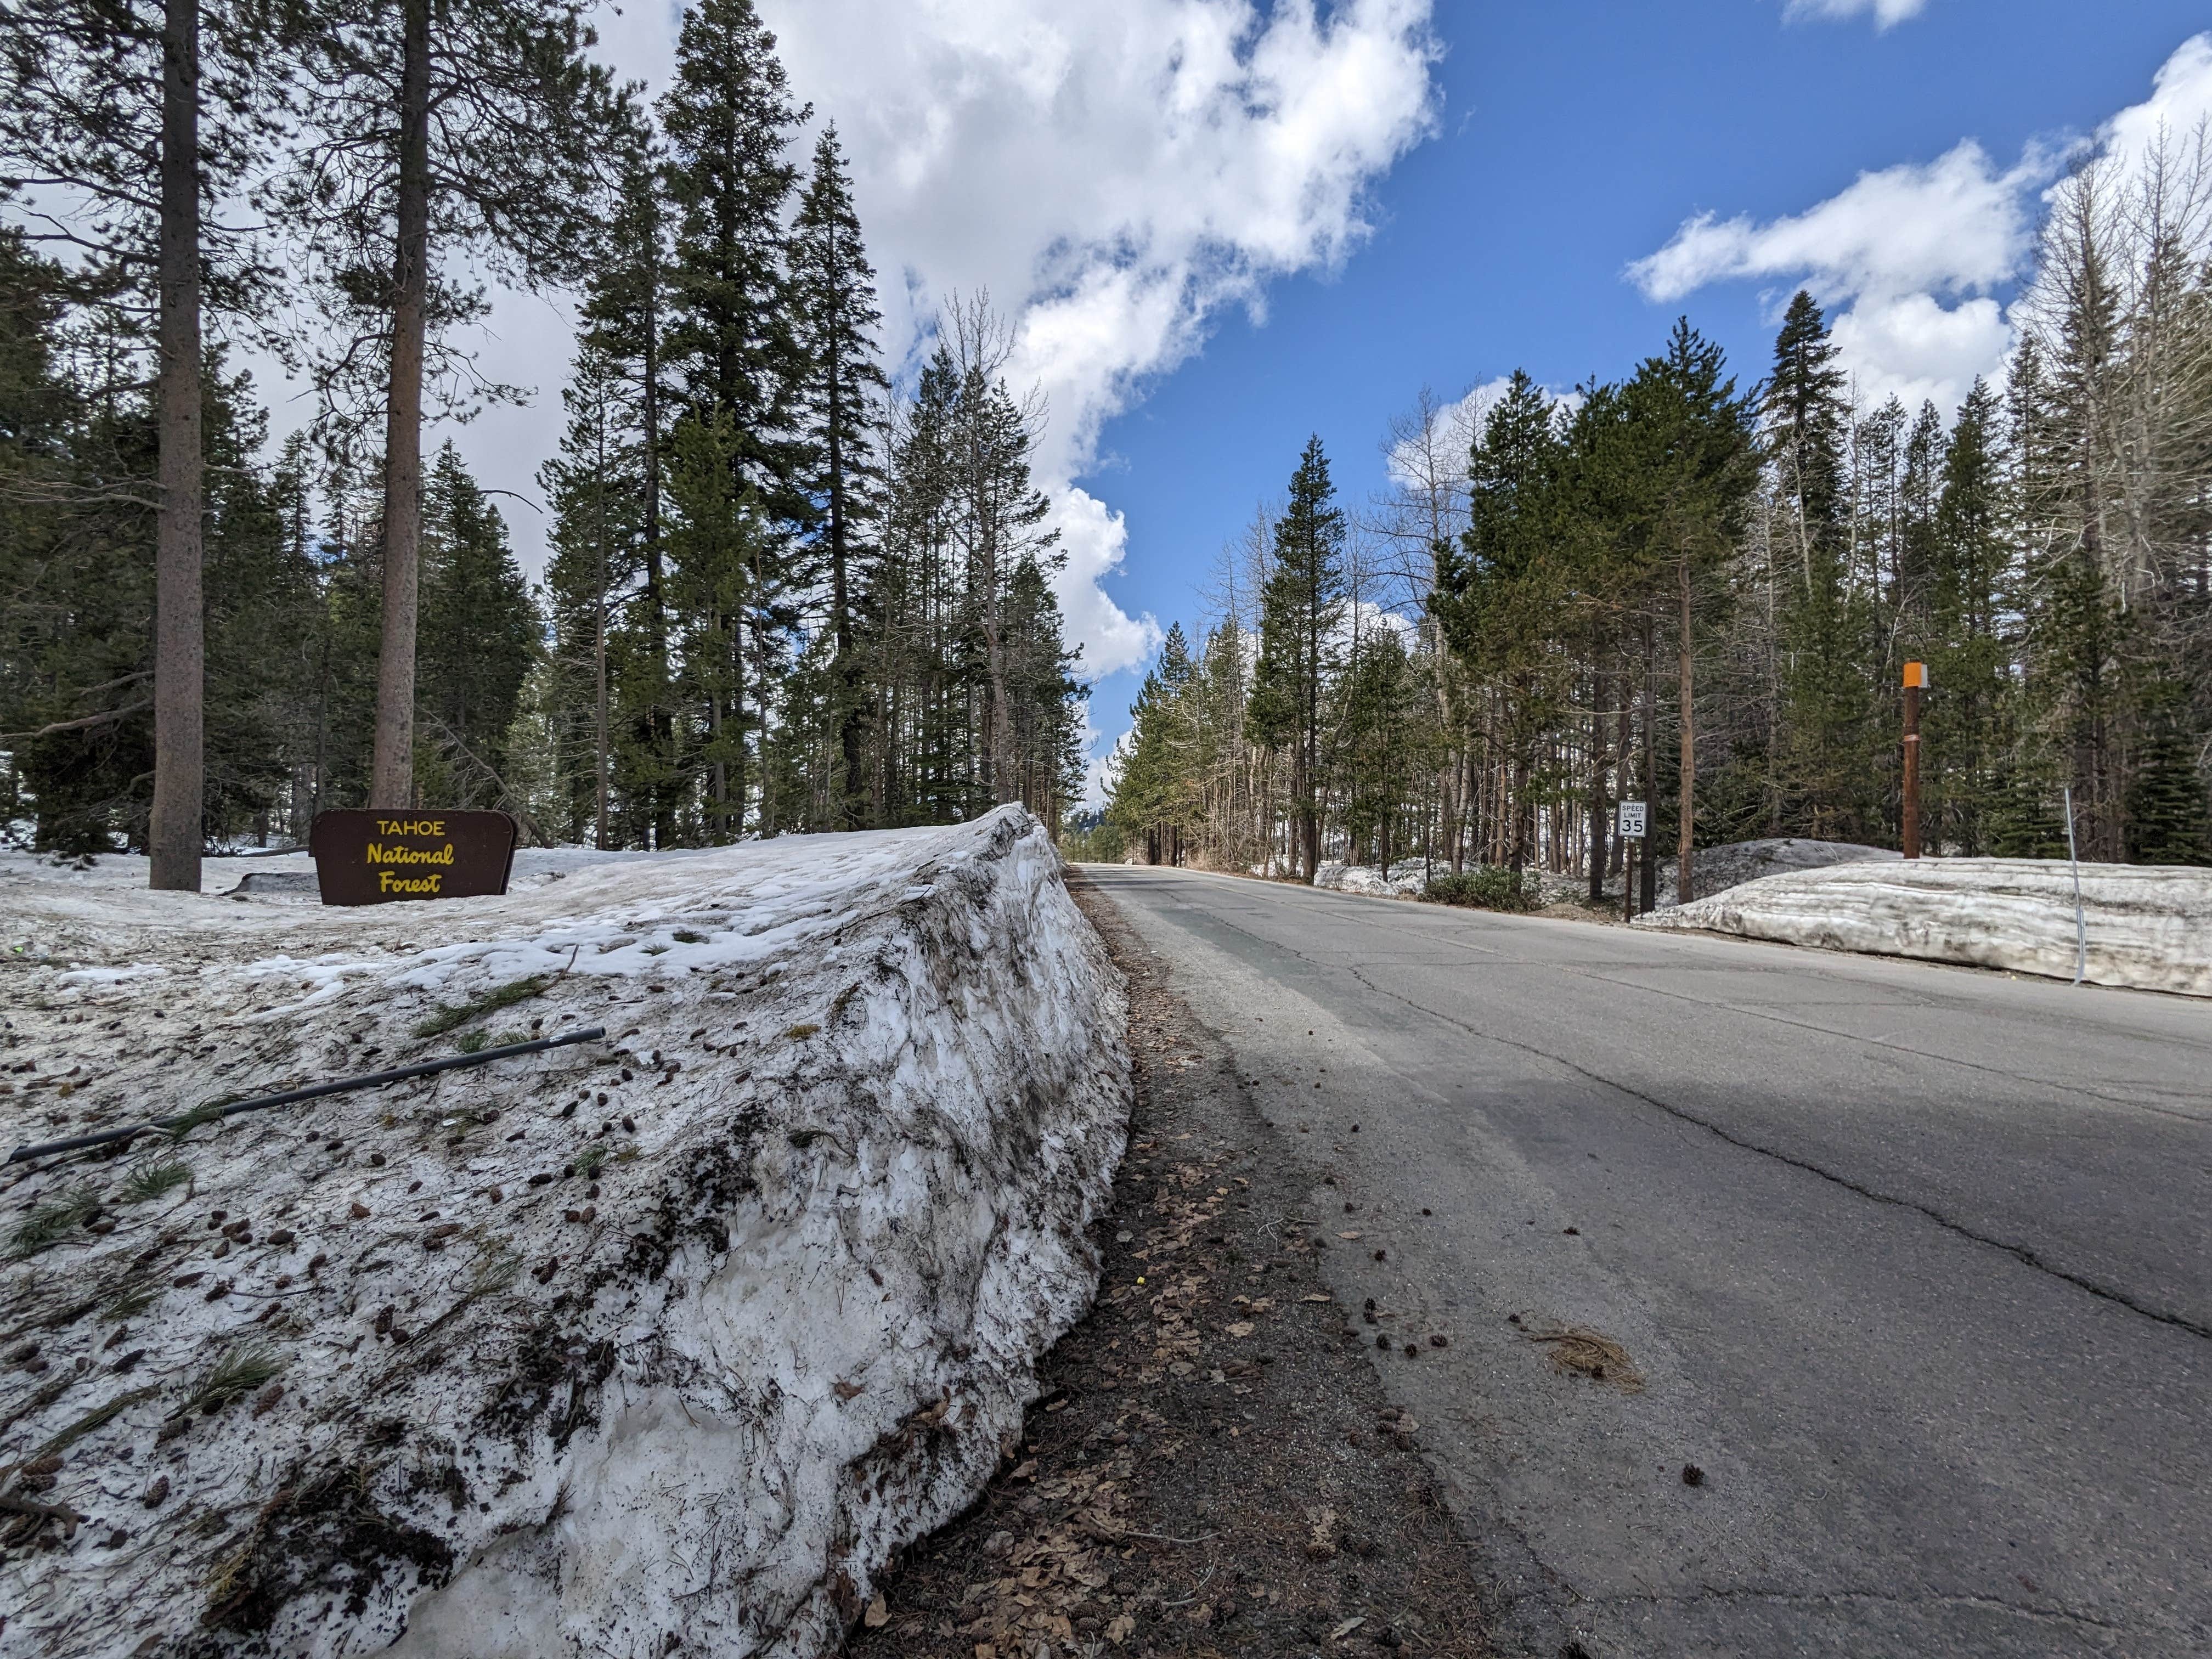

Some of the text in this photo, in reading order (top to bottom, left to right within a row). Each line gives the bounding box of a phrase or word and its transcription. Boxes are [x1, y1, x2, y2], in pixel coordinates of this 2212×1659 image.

[377, 820, 445, 836] TAHOE
[1622, 820, 1643, 832] 35
[366, 843, 454, 865] National
[378, 871, 442, 893] Forest
